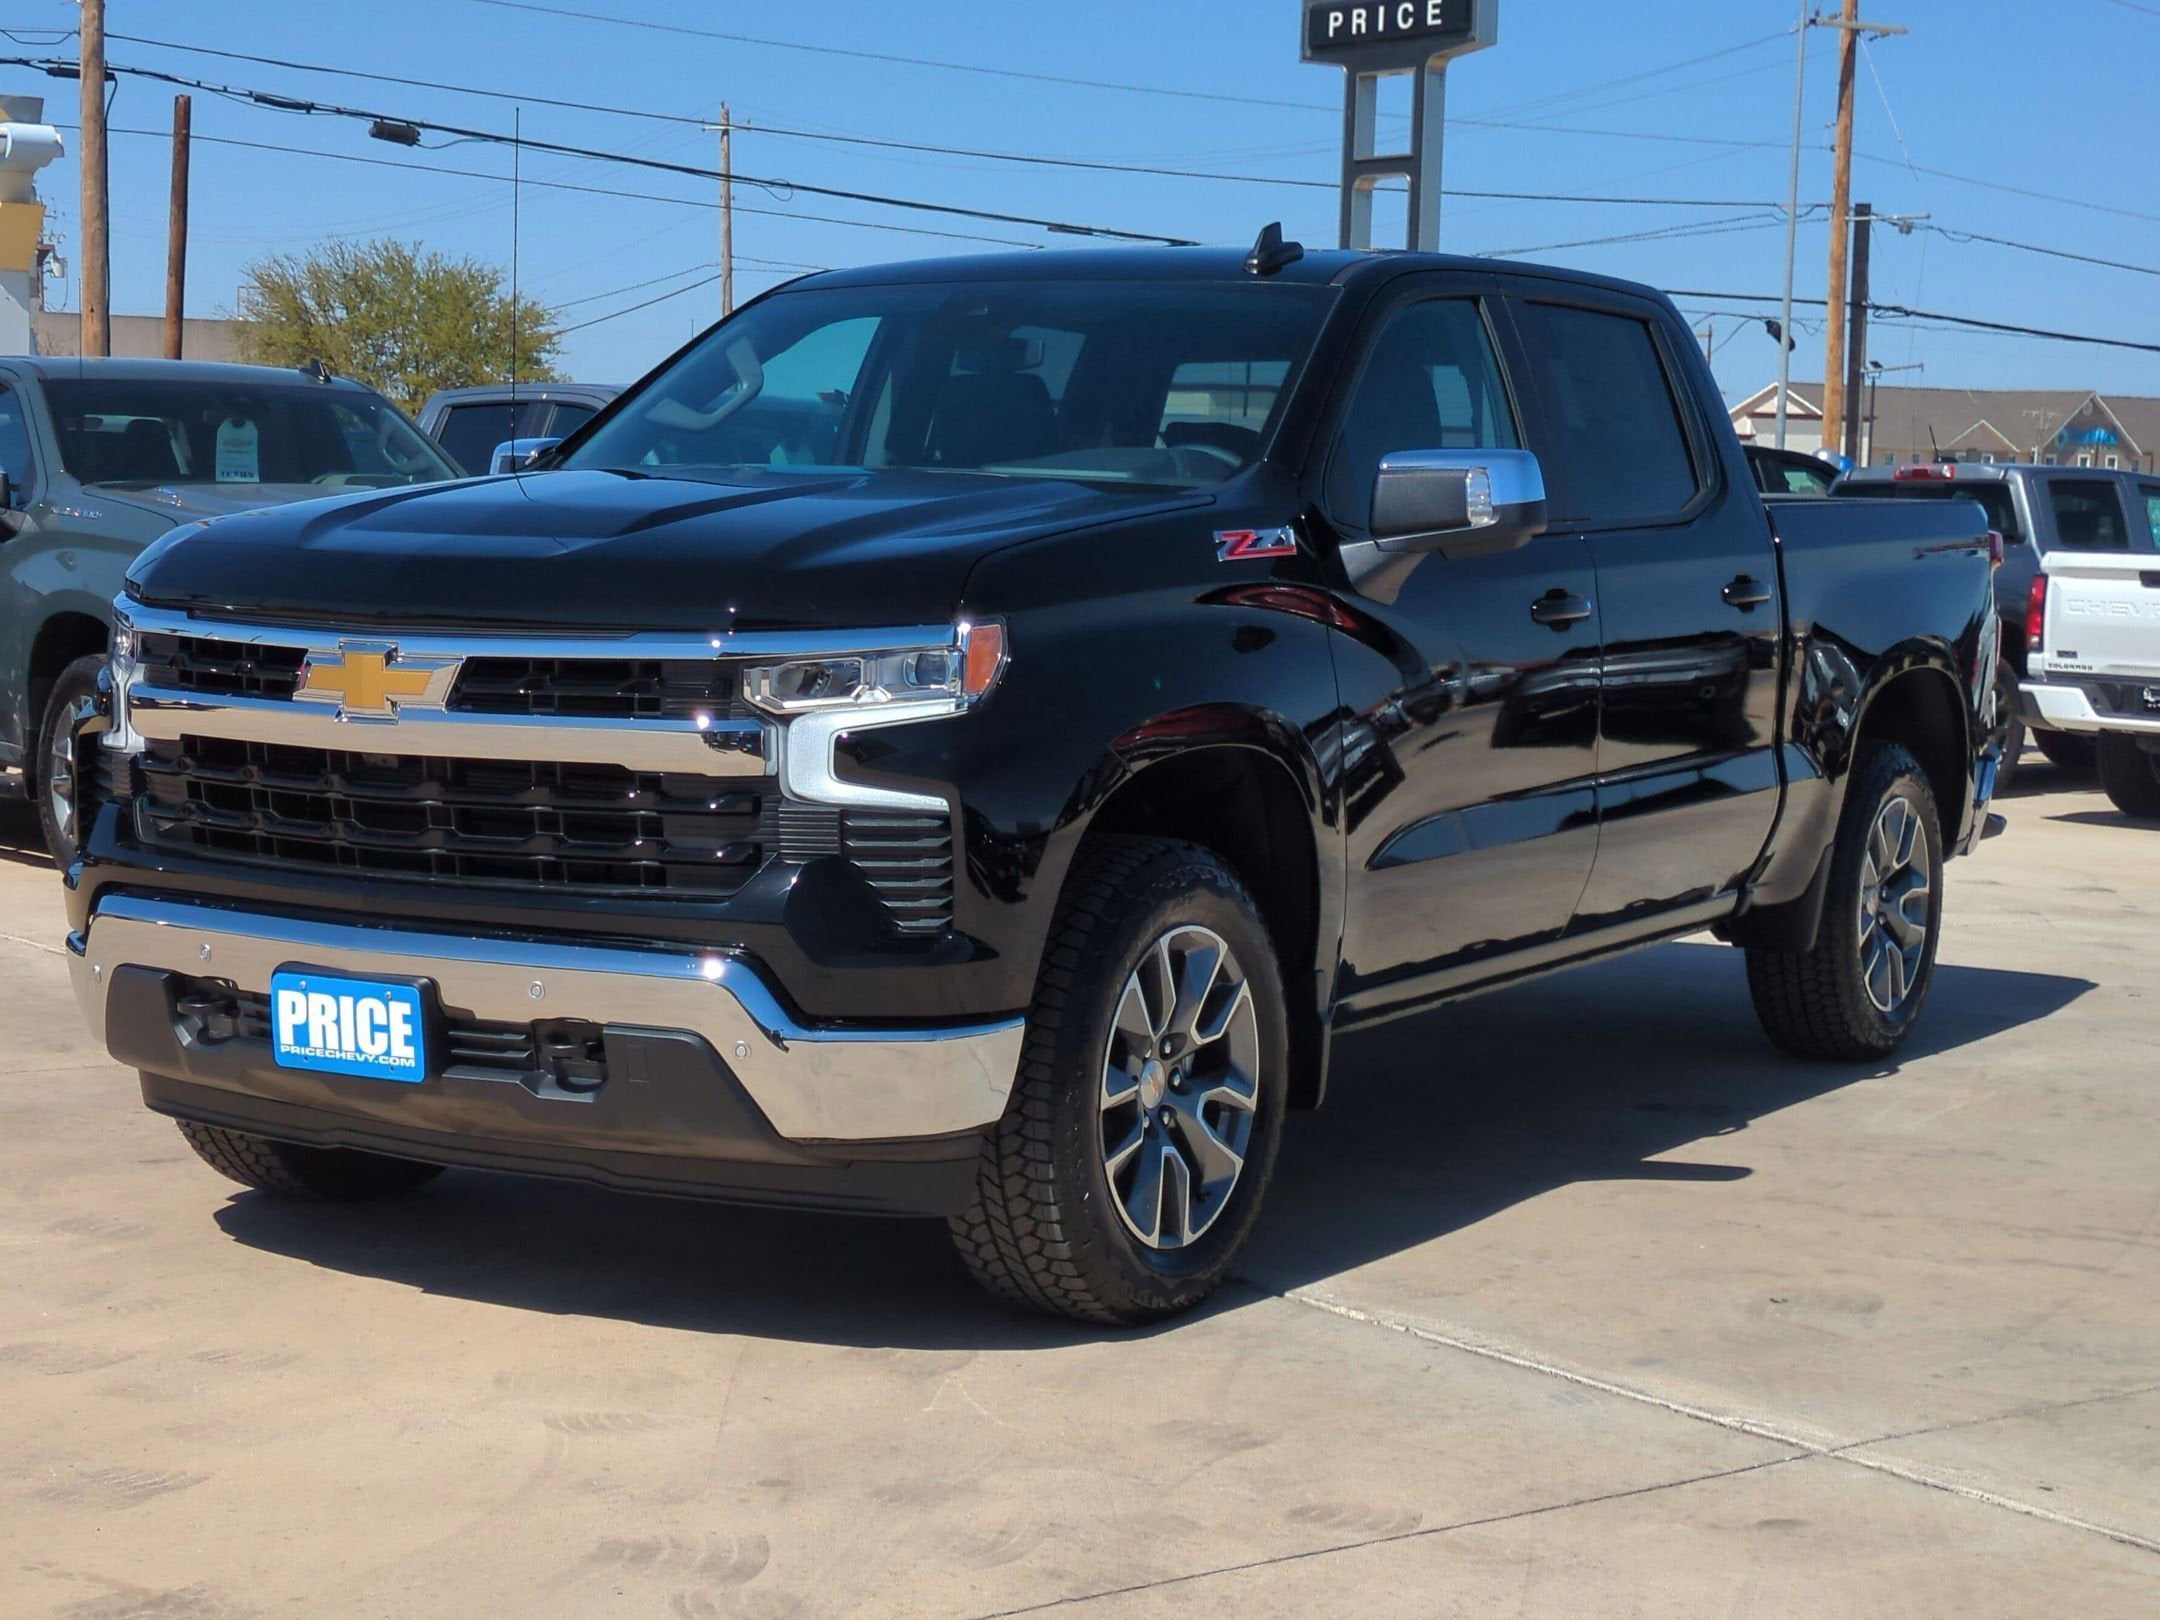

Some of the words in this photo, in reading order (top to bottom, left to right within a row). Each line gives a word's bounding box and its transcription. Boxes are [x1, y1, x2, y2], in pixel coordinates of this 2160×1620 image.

[1328, 0, 1443, 38] PRICE
[1213, 525, 1297, 562] Z71
[278, 989, 415, 1058] PRICE
[280, 1044, 415, 1068] PRICECHEVY.COM
